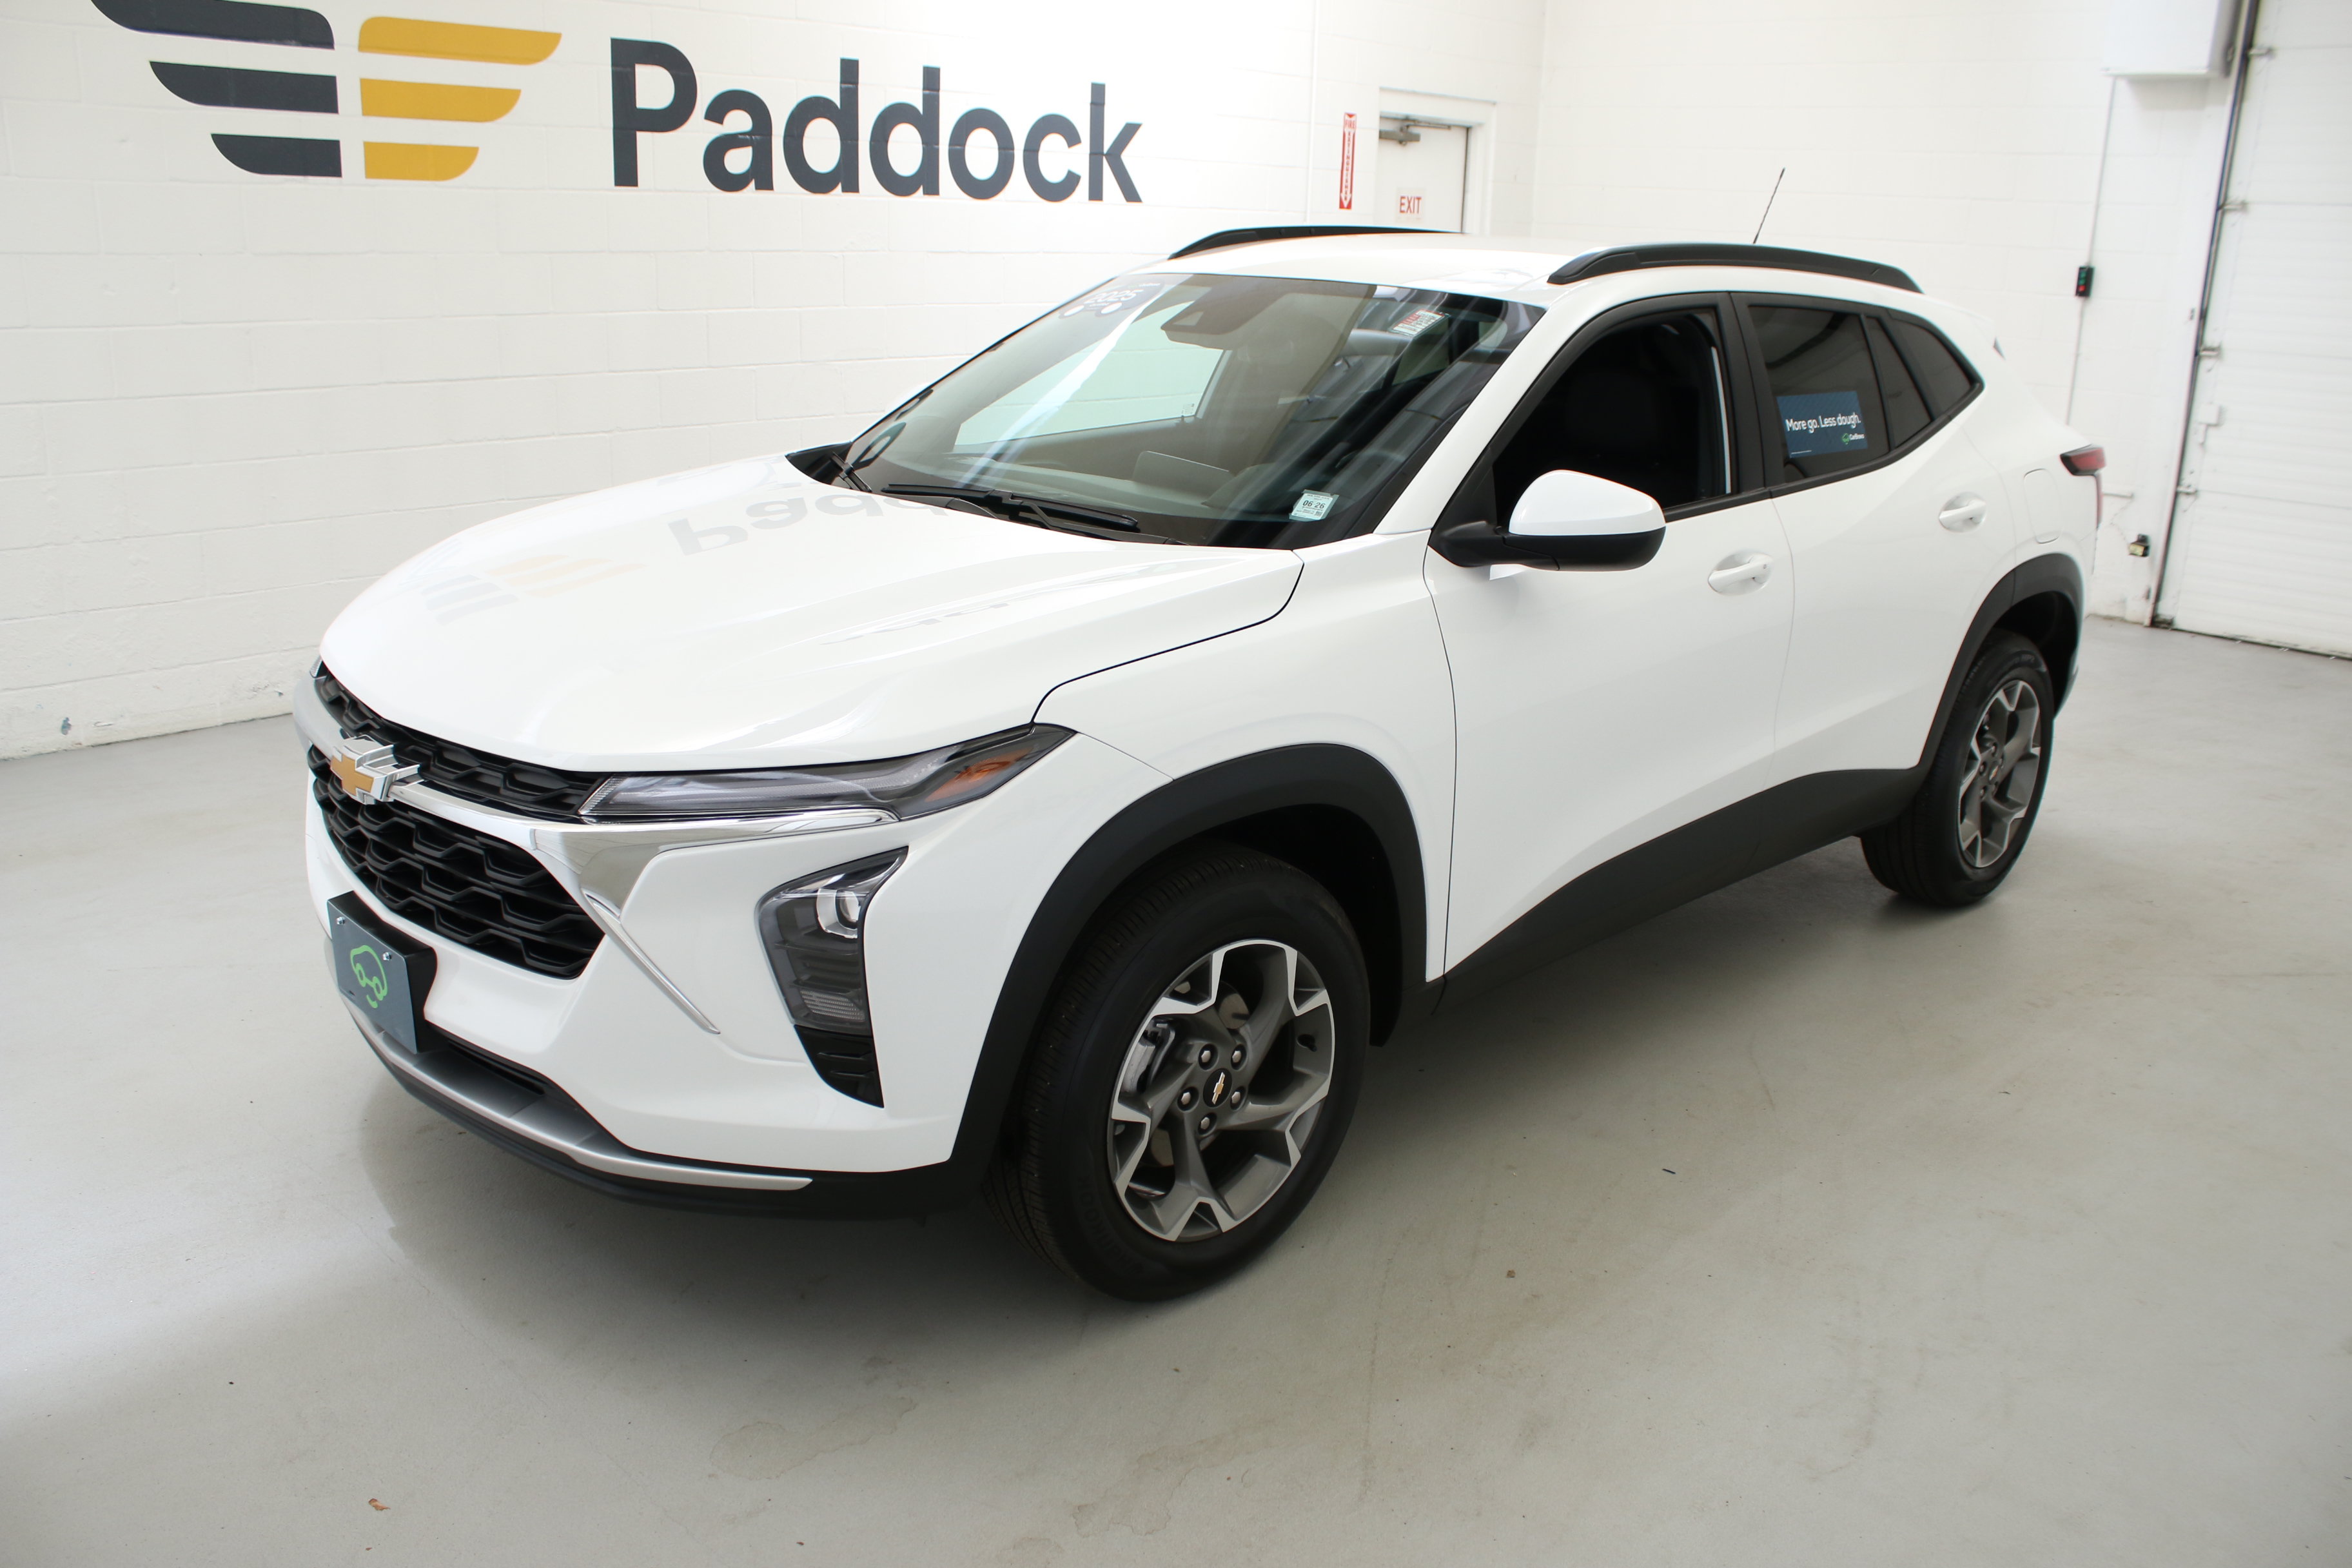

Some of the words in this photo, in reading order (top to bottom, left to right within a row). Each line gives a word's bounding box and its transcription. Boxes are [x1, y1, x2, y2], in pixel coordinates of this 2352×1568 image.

[610, 37, 1143, 203] Paddock
[1400, 195, 1422, 214] EXIT
[1785, 418, 1807, 431] More
[1807, 419, 1819, 433] go.
[1819, 415, 1837, 428] Less
[1837, 412, 1861, 429] dough.
